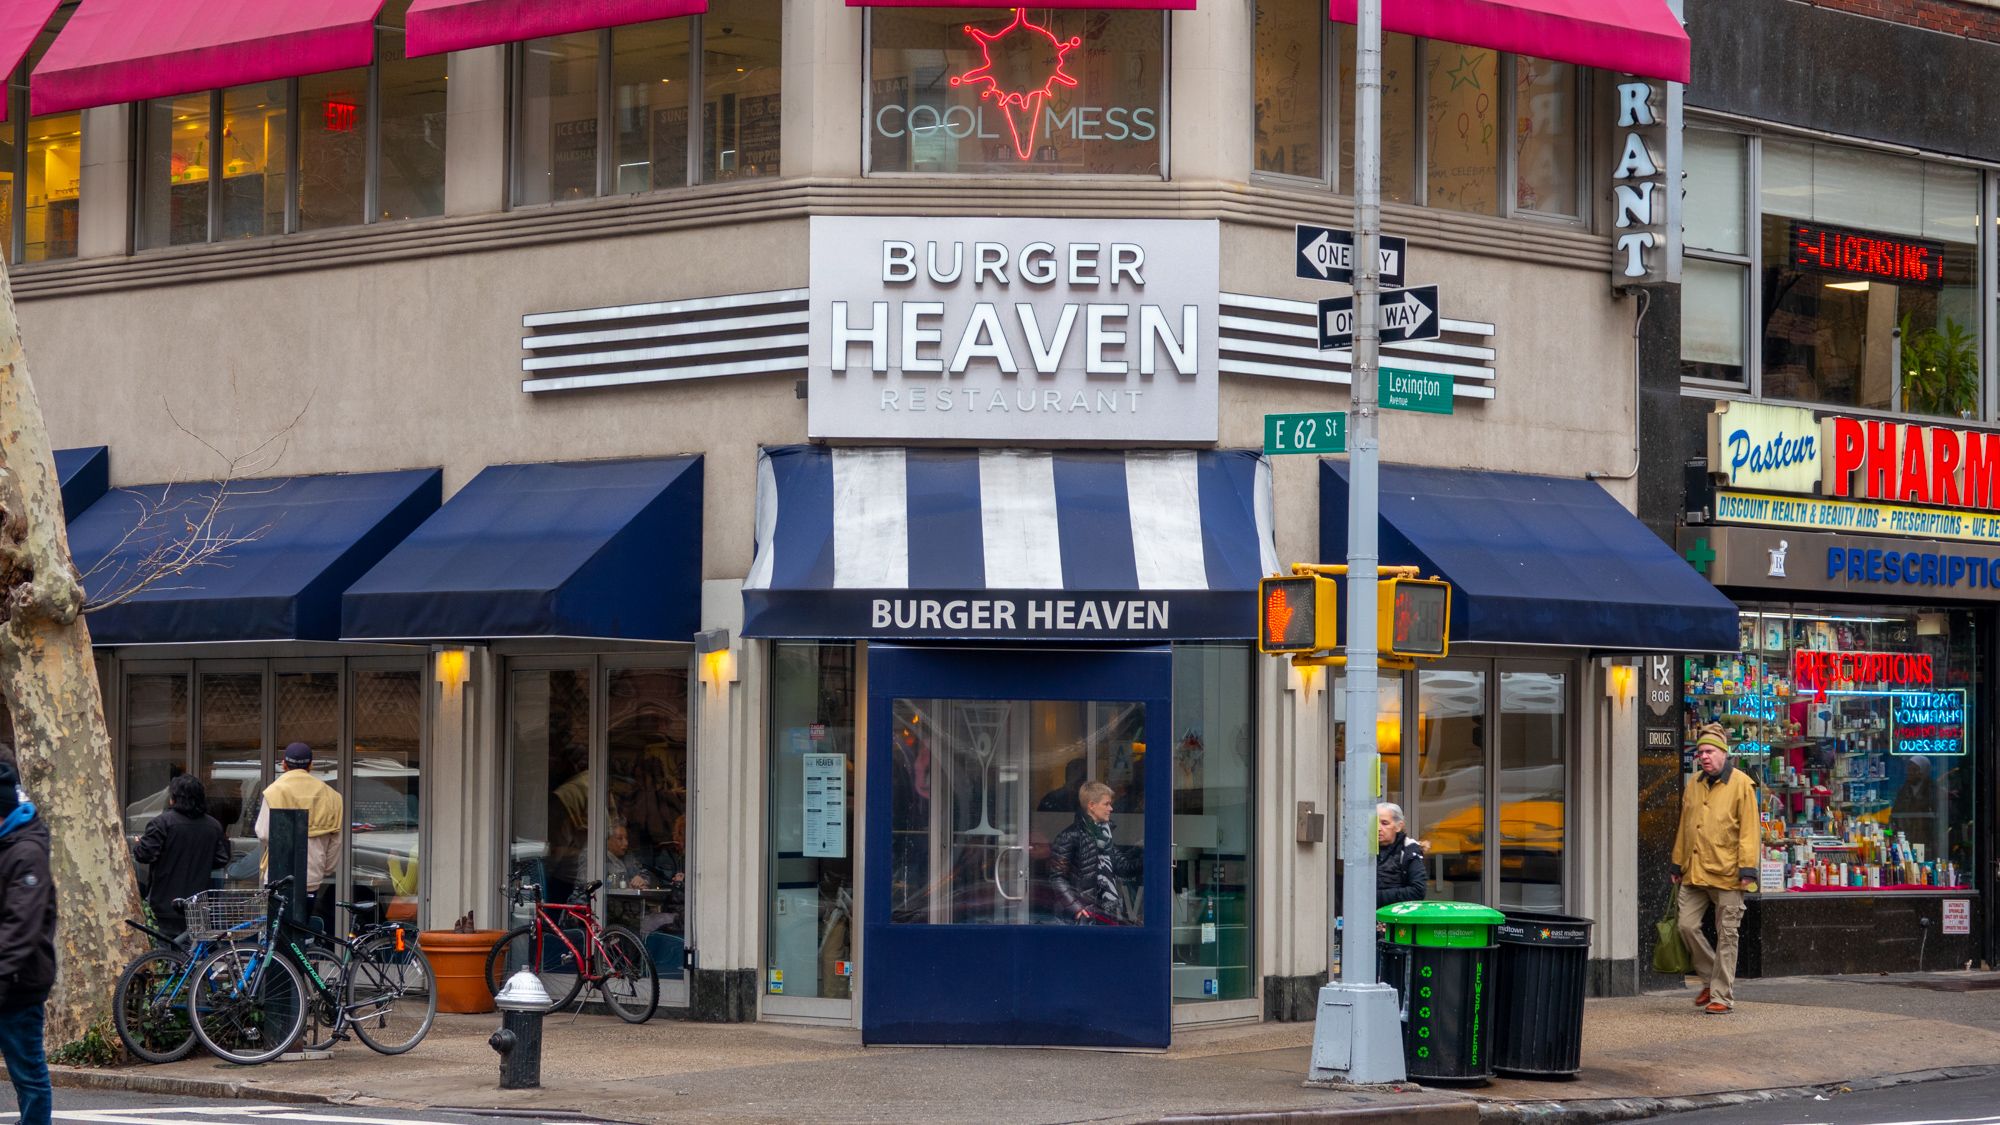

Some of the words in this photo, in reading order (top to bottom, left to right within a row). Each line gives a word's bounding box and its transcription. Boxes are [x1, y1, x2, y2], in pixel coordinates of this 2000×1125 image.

[327, 102, 357, 130] EXIT
[556, 122, 574, 136] ICE
[876, 103, 999, 141] COOL
[1045, 106, 1156, 141] MESS
[1613, 73, 1658, 278] RANT
[881, 240, 1146, 286] BURGER
[1317, 244, 1350, 267] ONE
[1385, 303, 1421, 327] WAY
[830, 300, 1199, 376] HEAVEN
[880, 387, 1144, 414] RESTAURANT
[1389, 372, 1440, 401] Lexington
[1389, 395, 1408, 406] Avenue
[1276, 420, 1285, 449] E
[1294, 418, 1316, 449] 62
[1325, 418, 1337, 437] St
[1729, 428, 1816, 483] Pasteur
[1718, 496, 1769, 520] DISCOUNT
[1771, 500, 1808, 523] HEALTH
[1809, 504, 1817, 523] &
[1818, 505, 1856, 527] BEAUTY
[1856, 508, 1879, 528] AIDS
[1890, 510, 1962, 535] PRESCRIPTIONS
[1972, 517, 1986, 536] WE
[872, 600, 1016, 629] BURGER
[1028, 600, 1169, 629] HEAVEN
[1796, 650, 1933, 684] PRESCRIPTIONS
[1651, 690, 1670, 703] 806
[1649, 732, 1671, 745] DRUGS
[815, 758, 834, 767] HEAVEN
[1564, 929, 1585, 938] midtown
[290, 942, 327, 990] cannondale
[1471, 962, 1483, 1066] NEWSPAPERS
